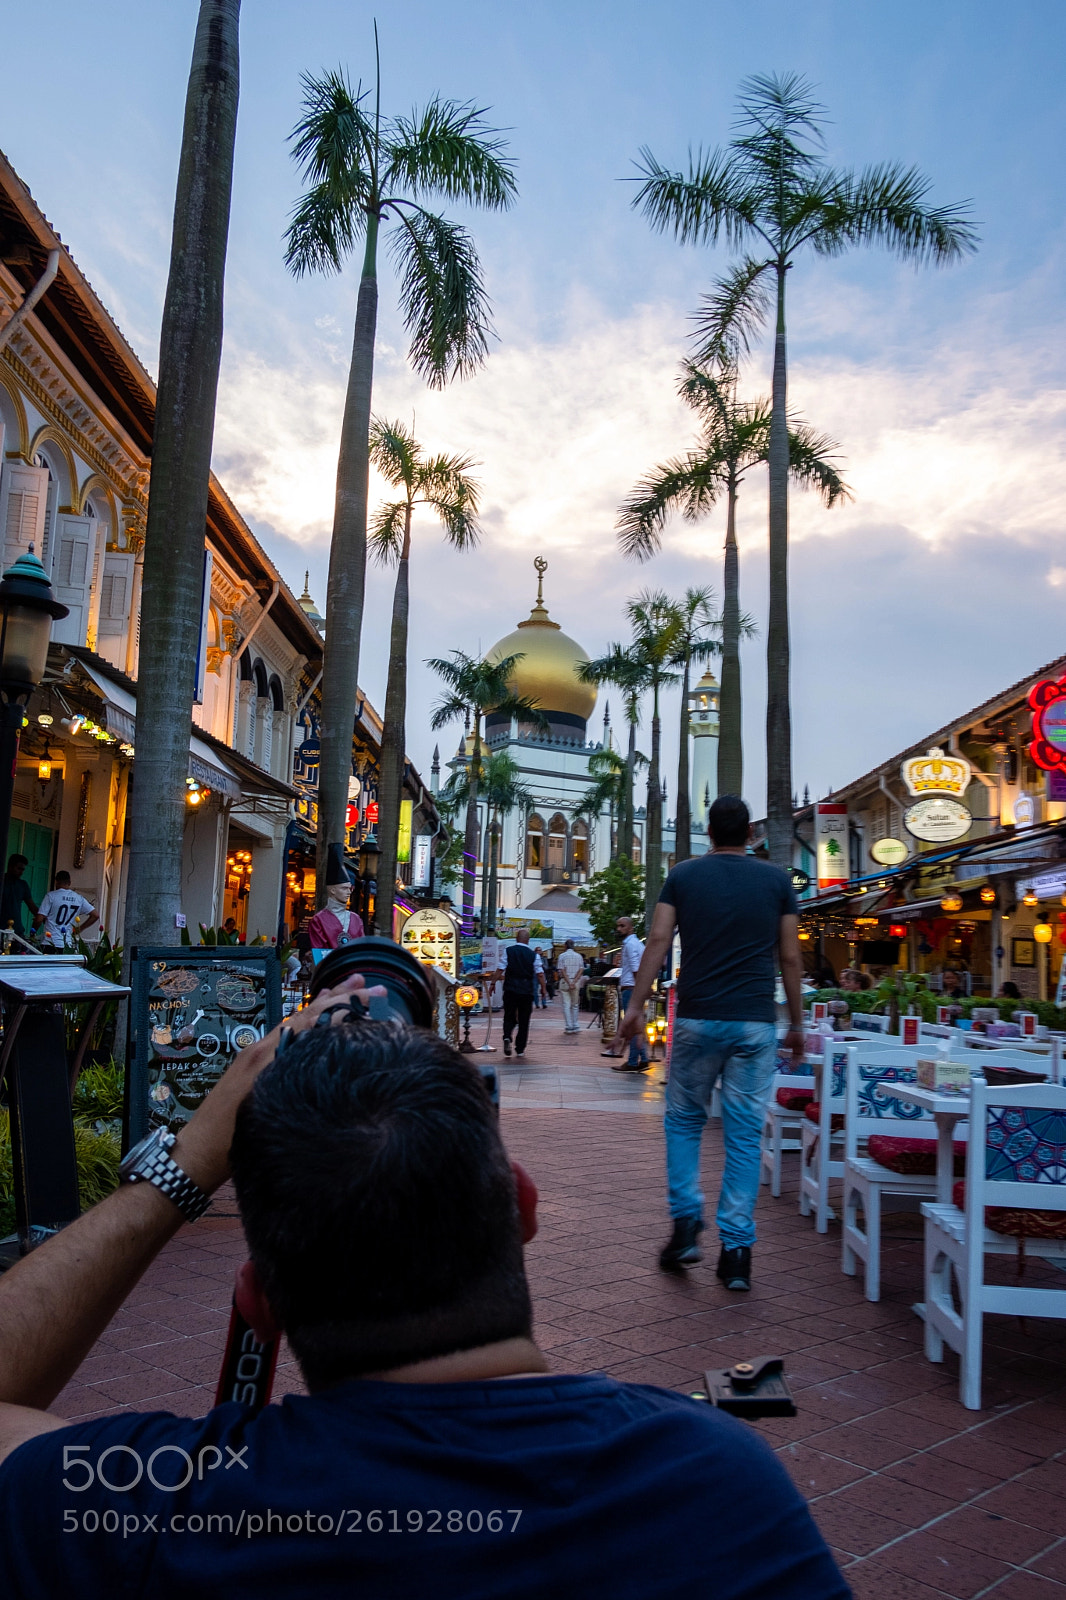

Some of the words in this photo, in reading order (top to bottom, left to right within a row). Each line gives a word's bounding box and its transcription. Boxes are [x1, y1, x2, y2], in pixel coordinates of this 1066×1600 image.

[191, 760, 227, 790] RESTAURANT
[56, 904, 80, 926] 07
[152, 961, 167, 972] $9
[149, 999, 191, 1011] NACHOS!
[161, 1062, 190, 1071] LEPAK
